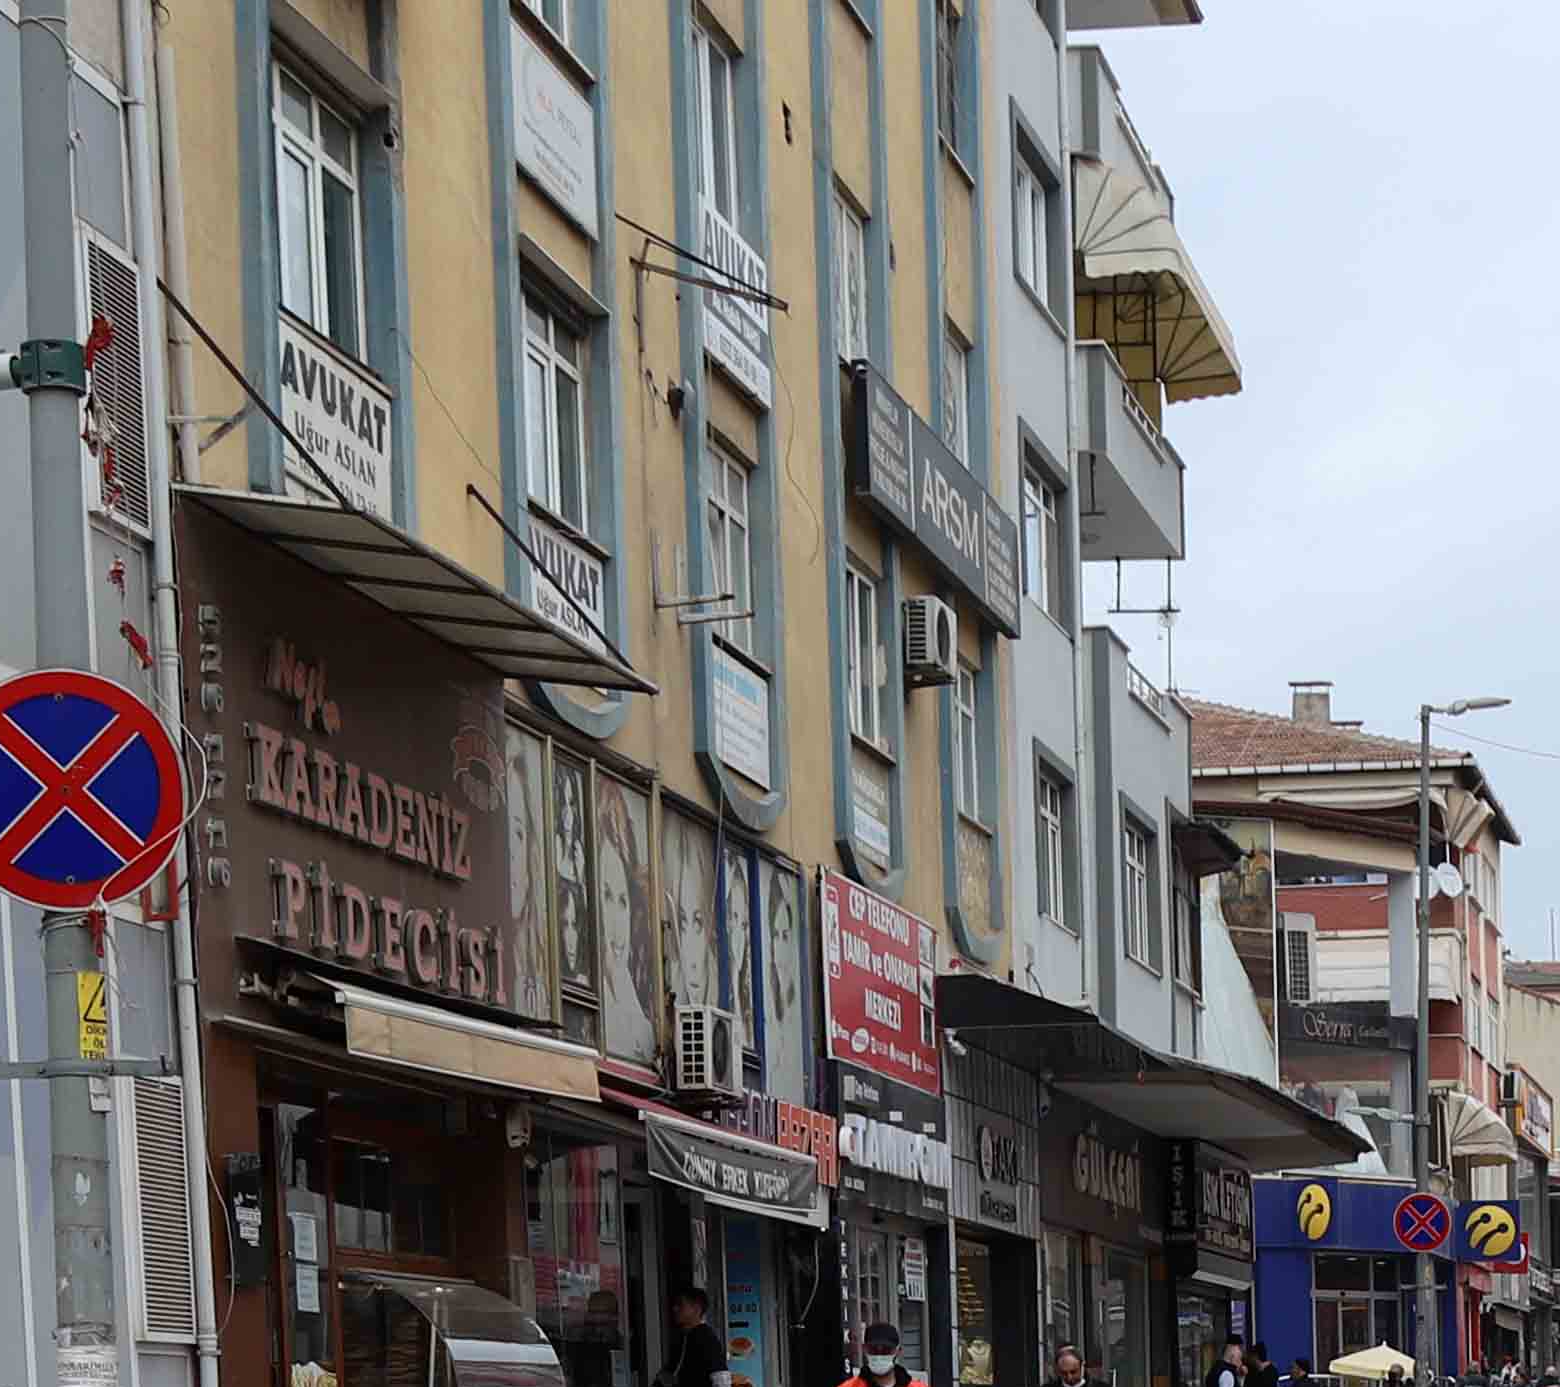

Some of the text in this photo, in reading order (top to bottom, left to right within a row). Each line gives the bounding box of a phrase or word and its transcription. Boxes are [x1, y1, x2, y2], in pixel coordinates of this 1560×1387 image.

[281, 340, 386, 456] AVUKAT
[294, 410, 376, 489] Uğur ASLAN
[922, 456, 981, 569] ARSM
[272, 858, 507, 1006] PİDECİSİ
[867, 897, 910, 947] TELEFONU
[864, 986, 903, 1032] MERKEZİ
